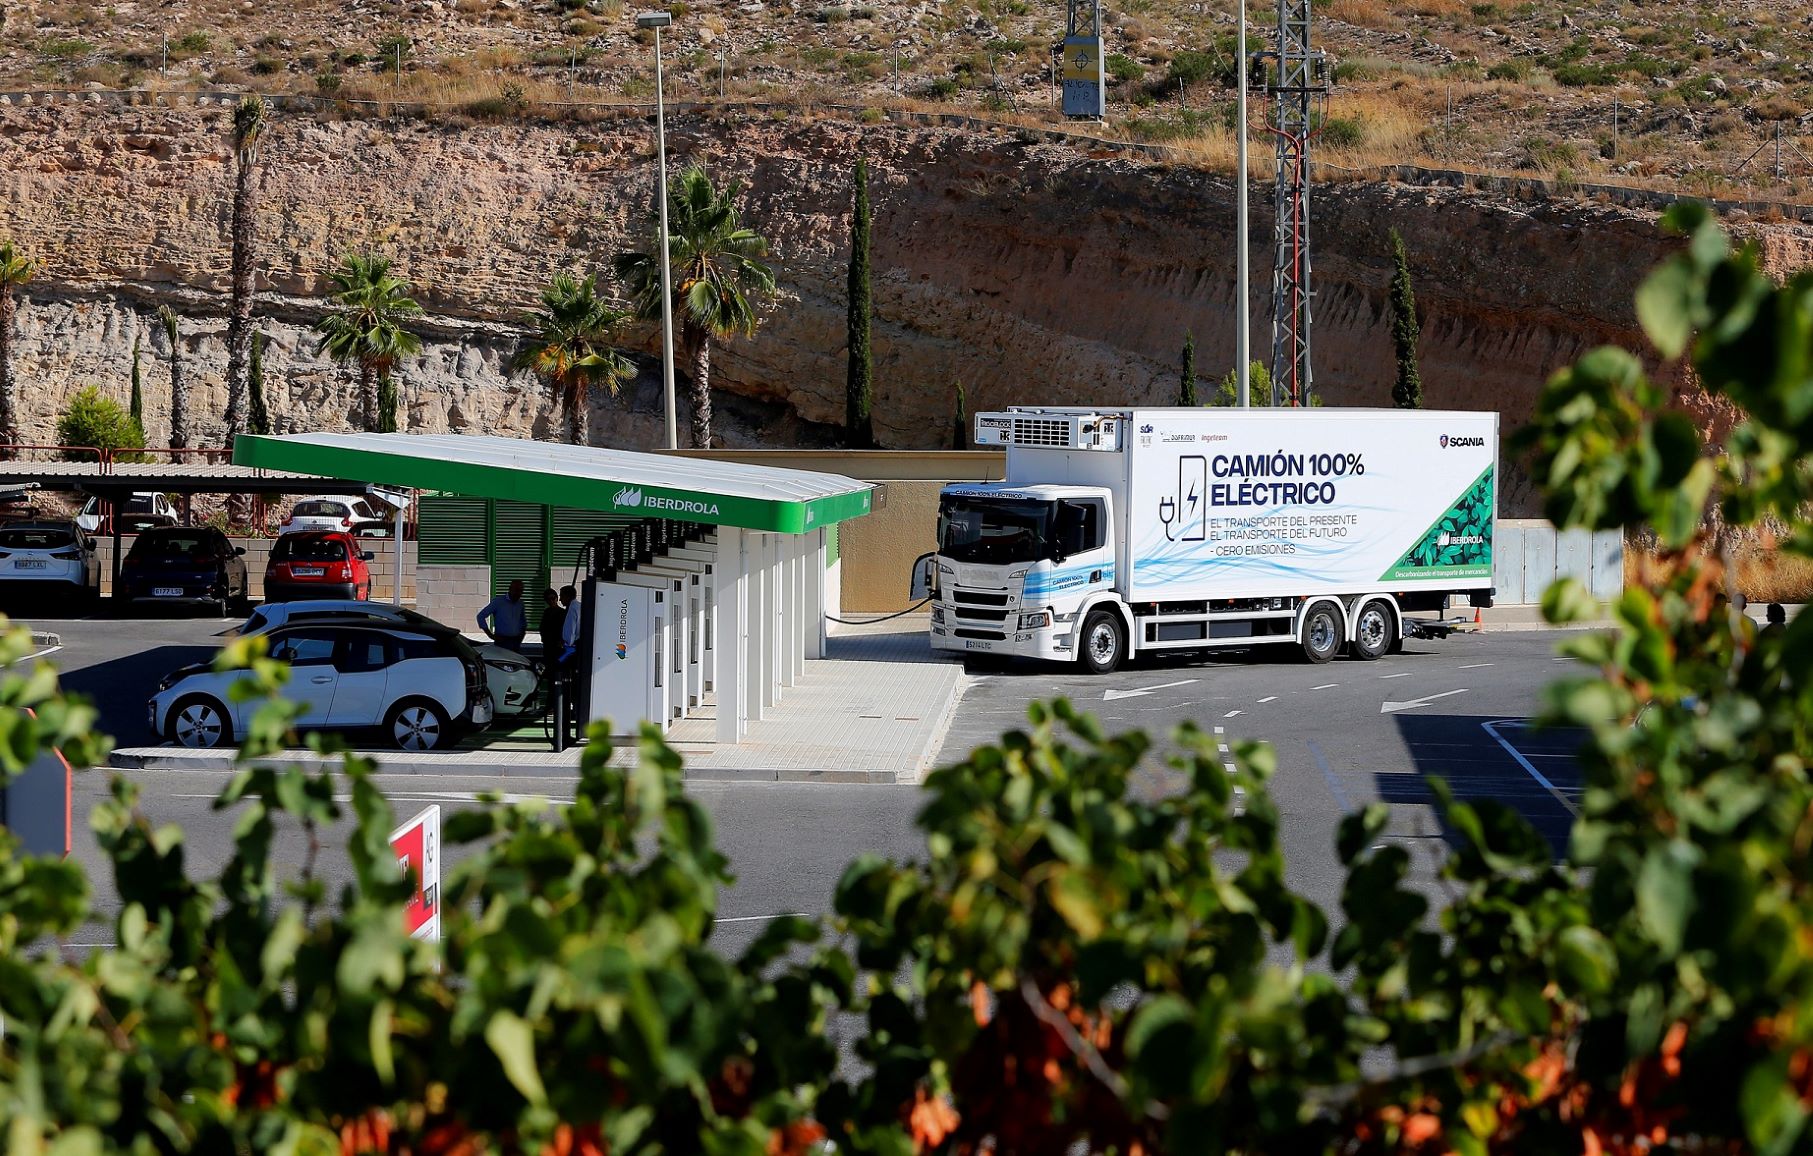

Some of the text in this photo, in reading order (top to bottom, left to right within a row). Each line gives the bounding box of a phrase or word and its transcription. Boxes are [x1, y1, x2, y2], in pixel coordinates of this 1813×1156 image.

[1450, 437, 1484, 447] SCANIA
[1212, 449, 1365, 477] CAMIÓN 100%
[1211, 478, 1336, 506] ELÉCTRICO
[643, 496, 719, 516] IBERDROLA
[1210, 515, 1357, 529] EL TRANSPORTE DEL PRESENTE
[1210, 527, 1347, 540] EL TRANSPORTE DEL FUTURO
[1450, 535, 1484, 544] IBERDROLA
[1215, 545, 1243, 557] CERO
[1245, 543, 1295, 556] EMISIONES
[619, 599, 628, 643] IBERDROLA
